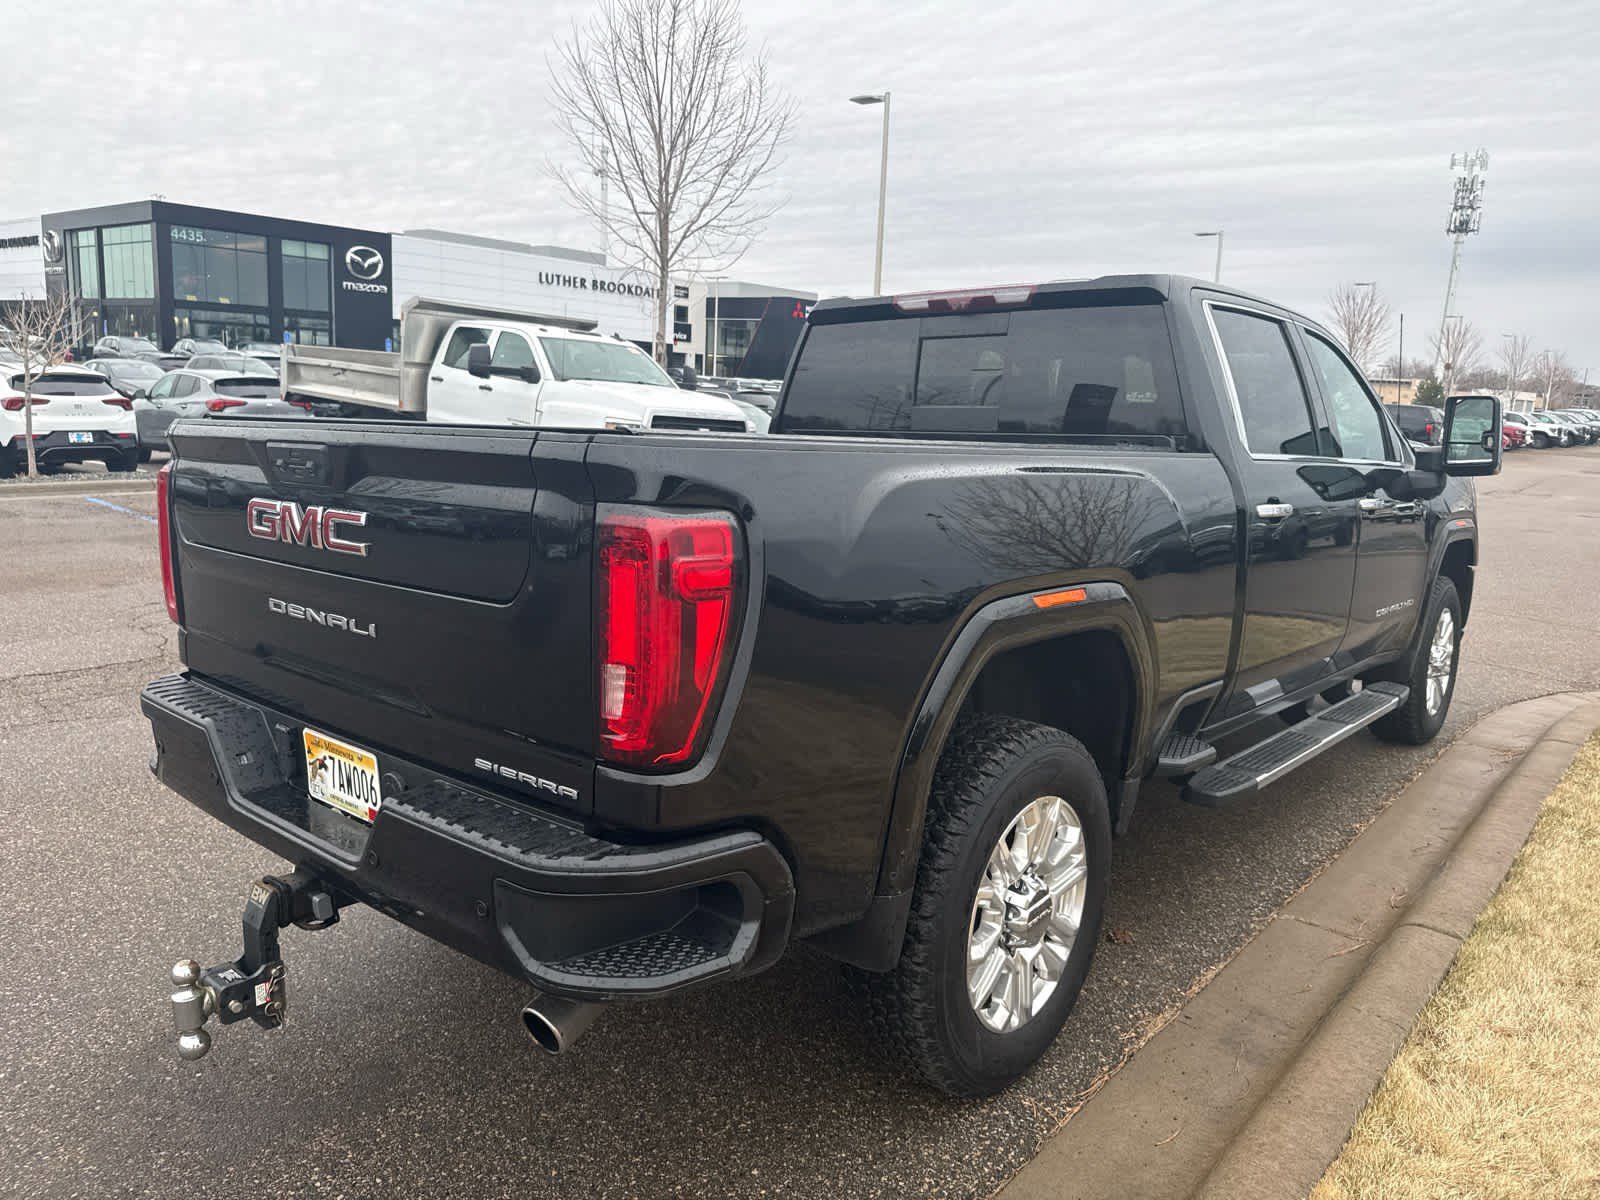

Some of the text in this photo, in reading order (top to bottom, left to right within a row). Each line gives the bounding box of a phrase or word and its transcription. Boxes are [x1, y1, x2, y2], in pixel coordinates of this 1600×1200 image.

[342, 280, 388, 294] mazda
[538, 271, 588, 290] LUTHER
[247, 497, 368, 558] GMC
[268, 597, 377, 638] DENALI
[327, 755, 378, 807] 7AW006
[474, 758, 578, 800] SIERRA
